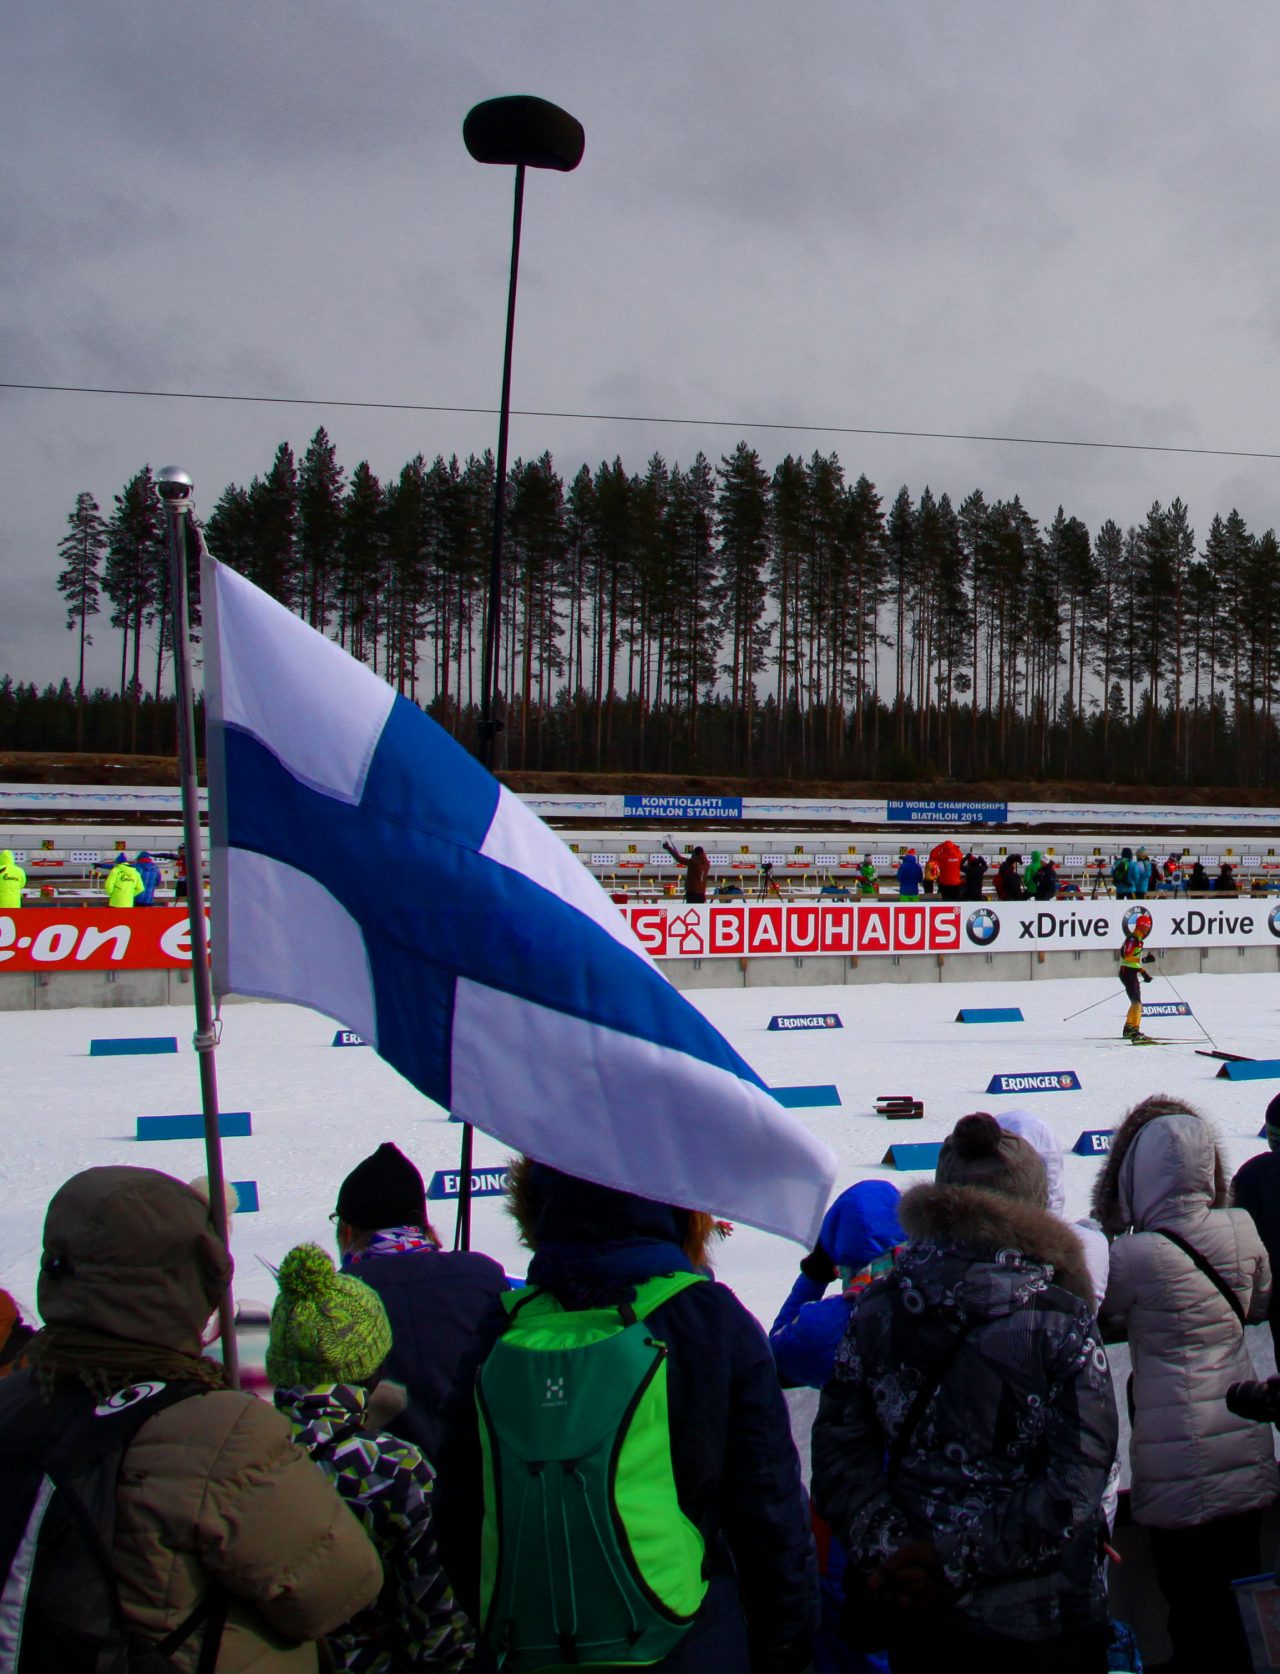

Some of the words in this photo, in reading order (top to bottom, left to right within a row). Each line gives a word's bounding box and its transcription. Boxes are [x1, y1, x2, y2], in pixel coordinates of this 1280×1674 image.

[641, 797, 722, 807] KONTIOLAHTI
[889, 801, 904, 809] IBU
[906, 801, 936, 809] WORLD
[938, 802, 1006, 810] CHAMPIONSHIPS
[625, 807, 683, 816] BIATHLON
[687, 808, 738, 817] STADIUM
[912, 812, 959, 820] BIATHLON
[961, 813, 984, 821] 2015
[1019, 912, 1110, 939] xDrive
[1171, 910, 1254, 936] xDrive
[716, 913, 958, 948] BAUHAUS
[1141, 1005, 1178, 1015] RDINGER
[778, 1017, 826, 1028] ERDINGER
[1001, 1074, 1060, 1091] ERDINGER
